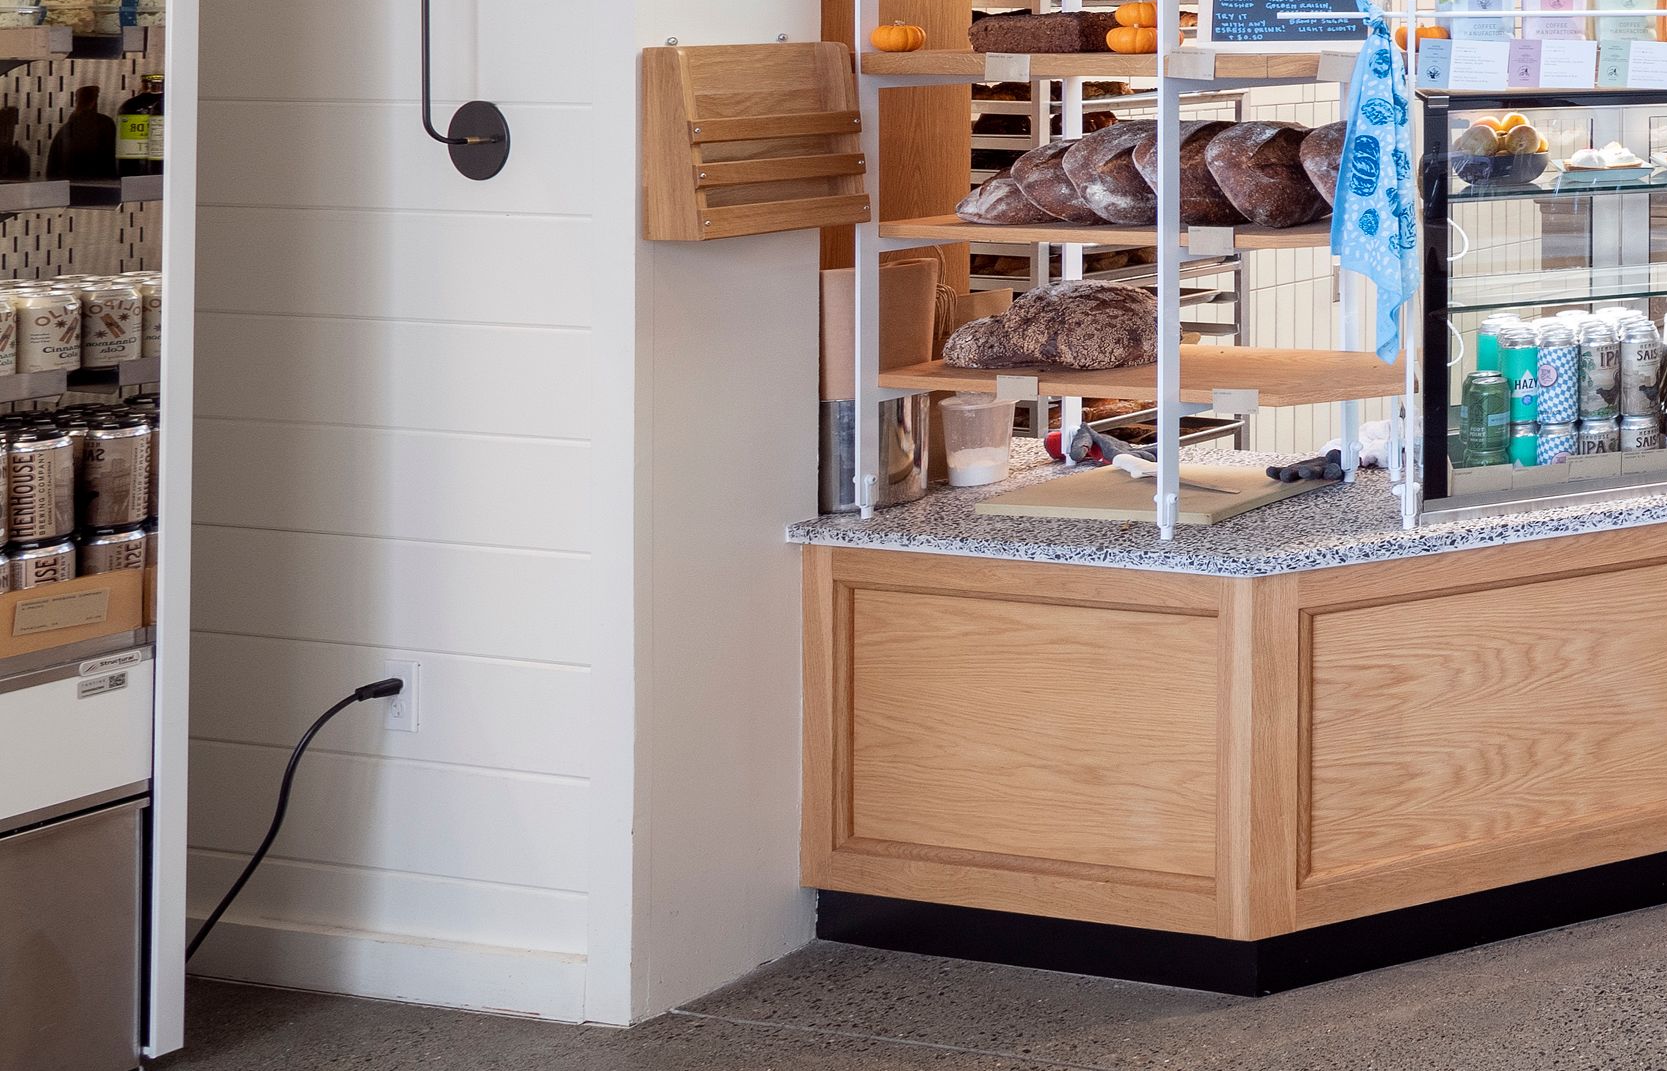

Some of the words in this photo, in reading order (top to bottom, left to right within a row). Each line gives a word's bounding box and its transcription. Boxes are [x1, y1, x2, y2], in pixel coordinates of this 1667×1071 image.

[1215, 13, 1234, 21] TRY
[1514, 378, 1538, 390] HAZY
[38, 452, 46, 493] COMPANY
[11, 455, 35, 538] HENHOUSE
[38, 497, 46, 536] BREWING
[100, 655, 135, 667] Structural
